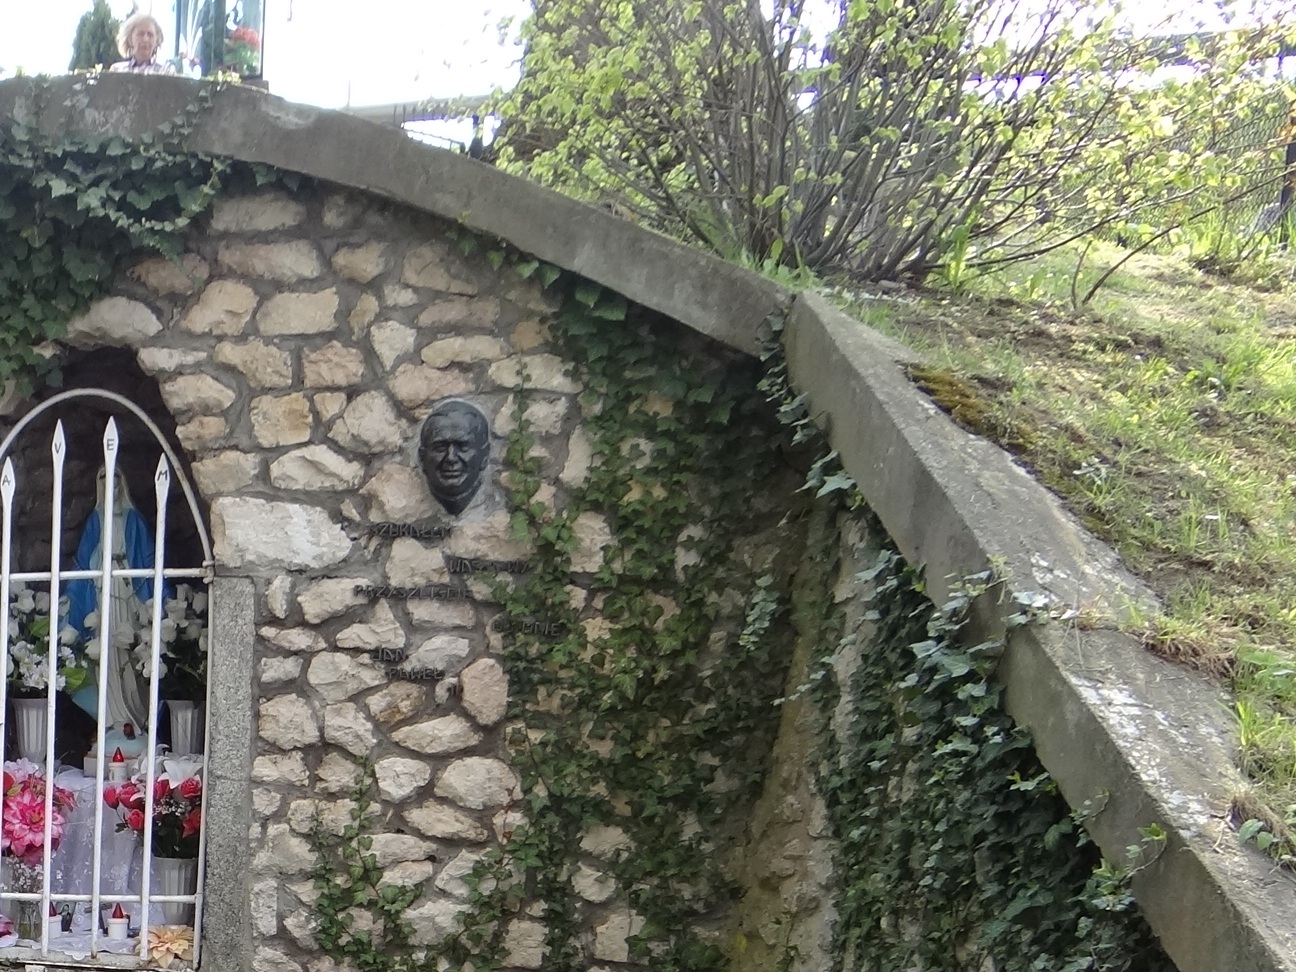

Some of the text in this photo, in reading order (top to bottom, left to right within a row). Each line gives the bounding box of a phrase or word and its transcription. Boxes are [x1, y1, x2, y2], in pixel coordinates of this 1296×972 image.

[2, 439, 168, 486] A V E M
[372, 648, 405, 661] JAN
[388, 667, 444, 680] PAWEŁ
